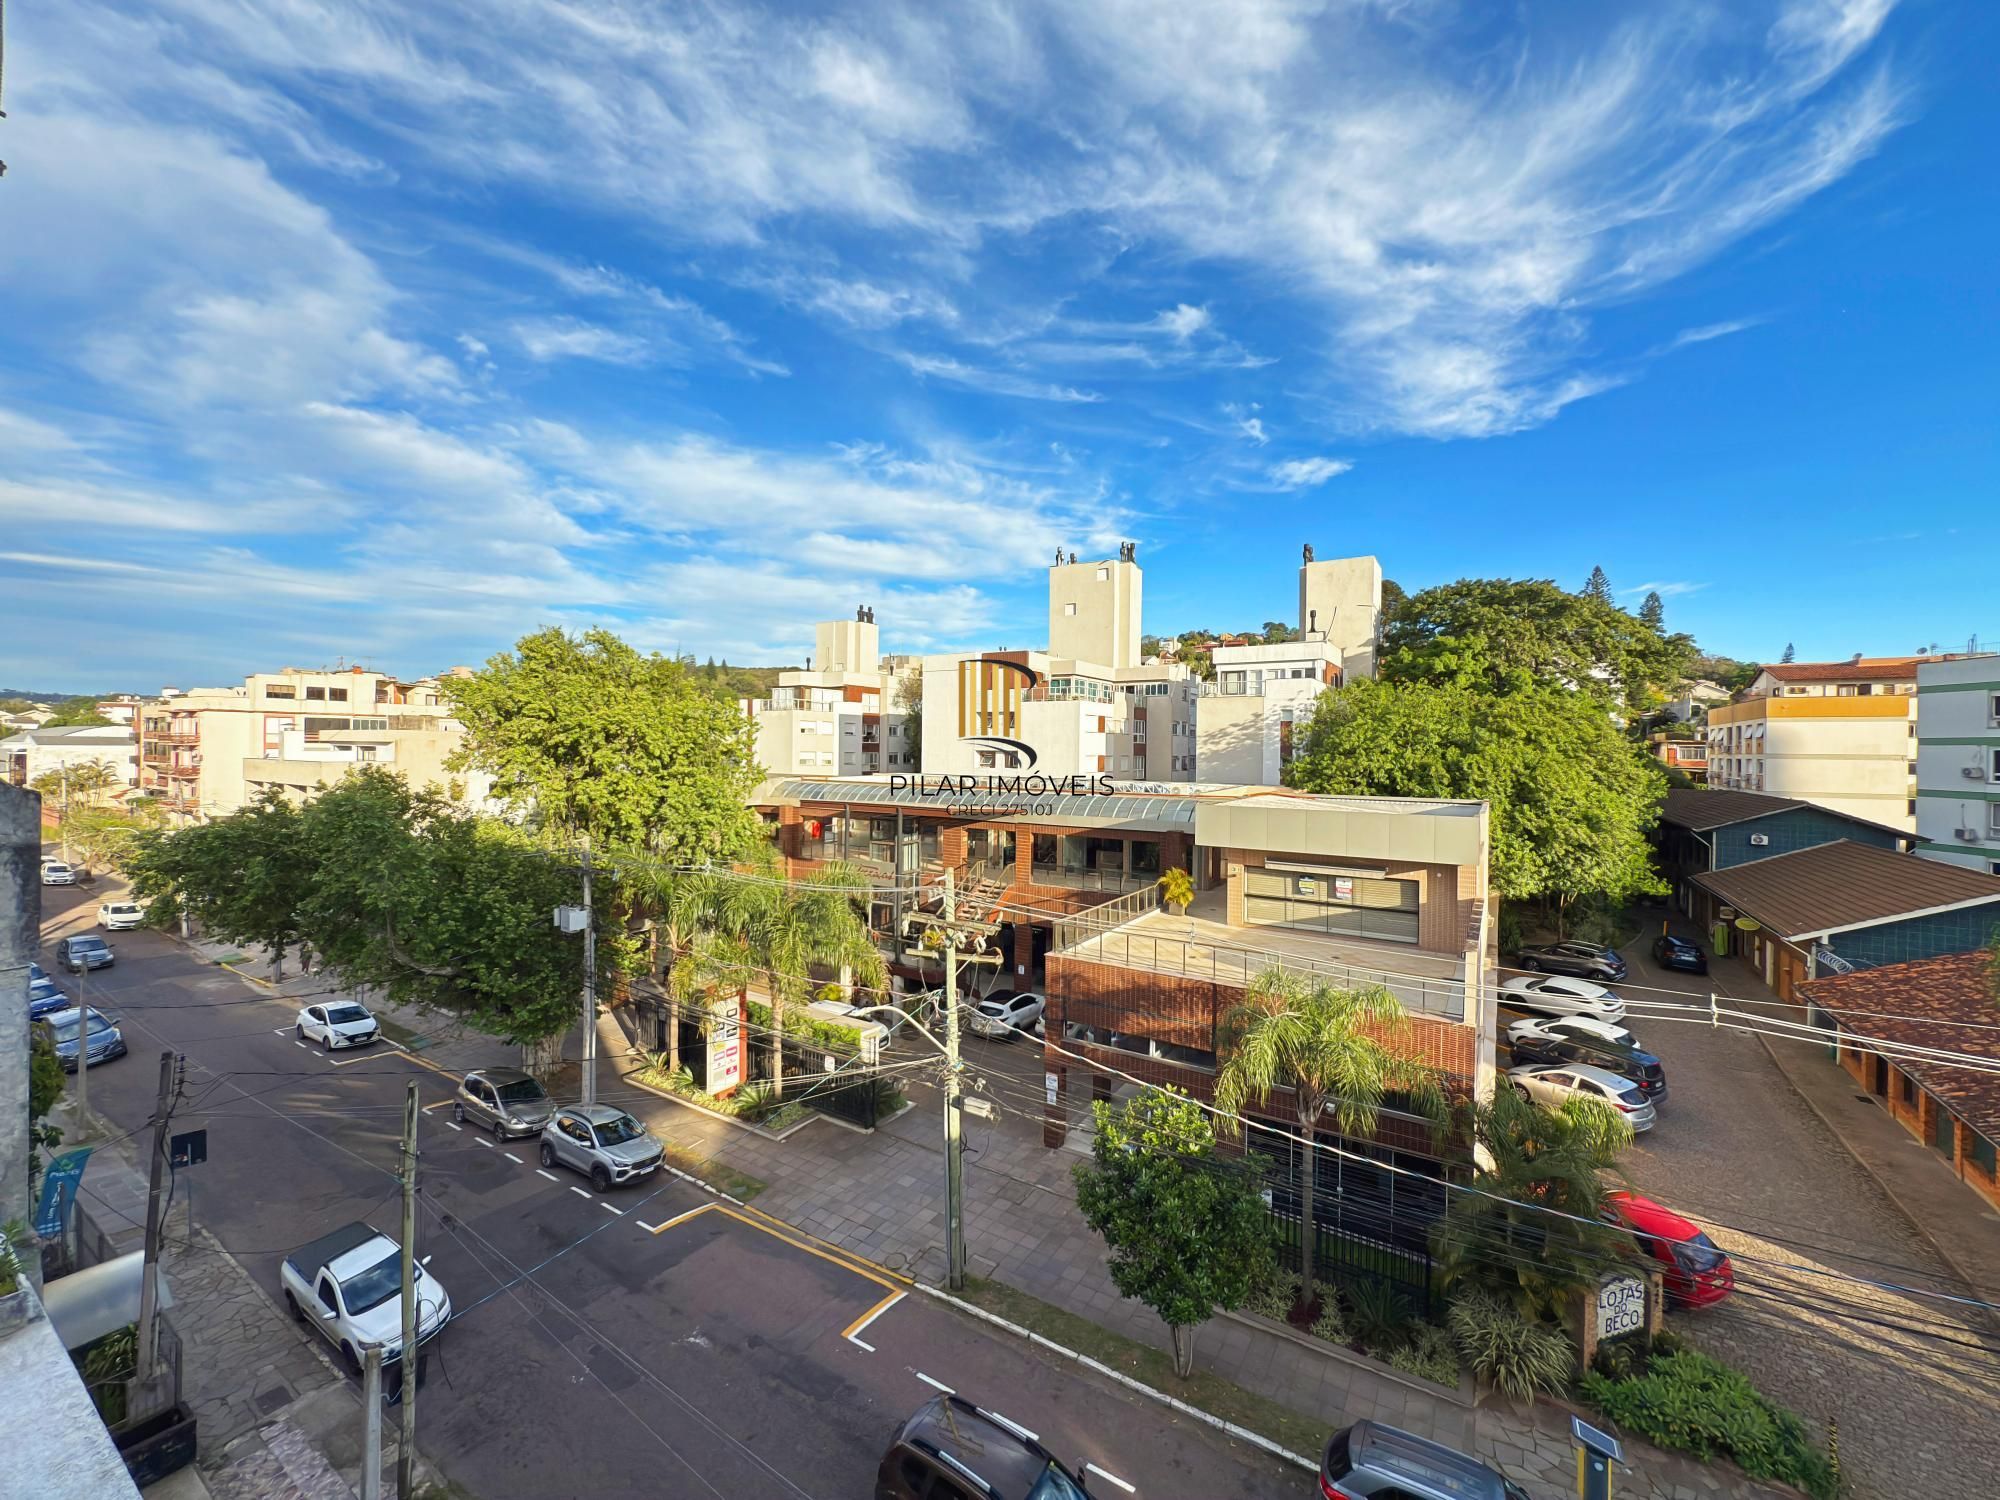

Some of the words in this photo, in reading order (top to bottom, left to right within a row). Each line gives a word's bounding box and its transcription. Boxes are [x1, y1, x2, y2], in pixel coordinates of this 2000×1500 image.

[1599, 1282, 1643, 1309] LOJAS
[1614, 1303, 1628, 1315] DO
[1605, 1310, 1640, 1333] BECO
